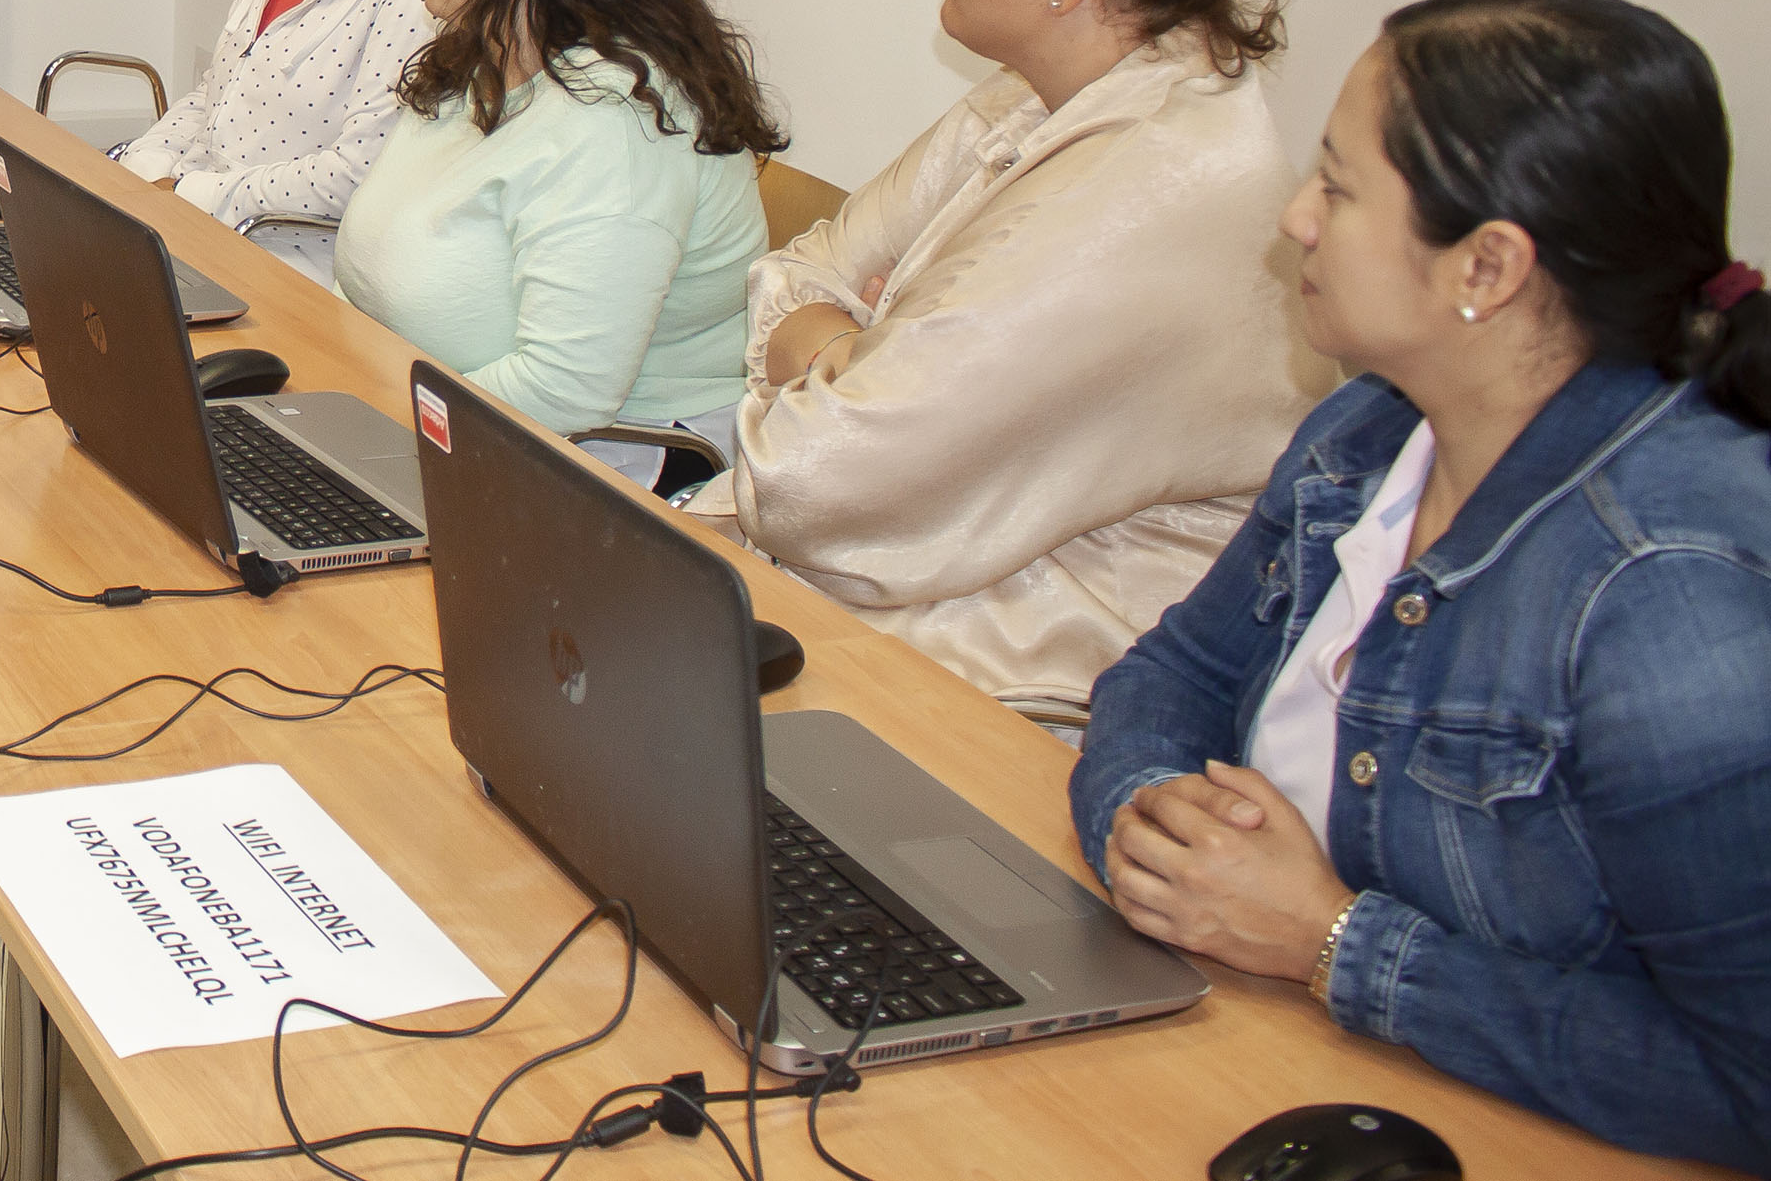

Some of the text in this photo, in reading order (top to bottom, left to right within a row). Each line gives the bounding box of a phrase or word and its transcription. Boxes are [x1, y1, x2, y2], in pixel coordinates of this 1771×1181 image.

[66, 817, 234, 1006] UFX7675NMLCHELQL
[133, 817, 293, 986] VODAFONEBA1171
[232, 818, 376, 952] WIFI INTERNET
